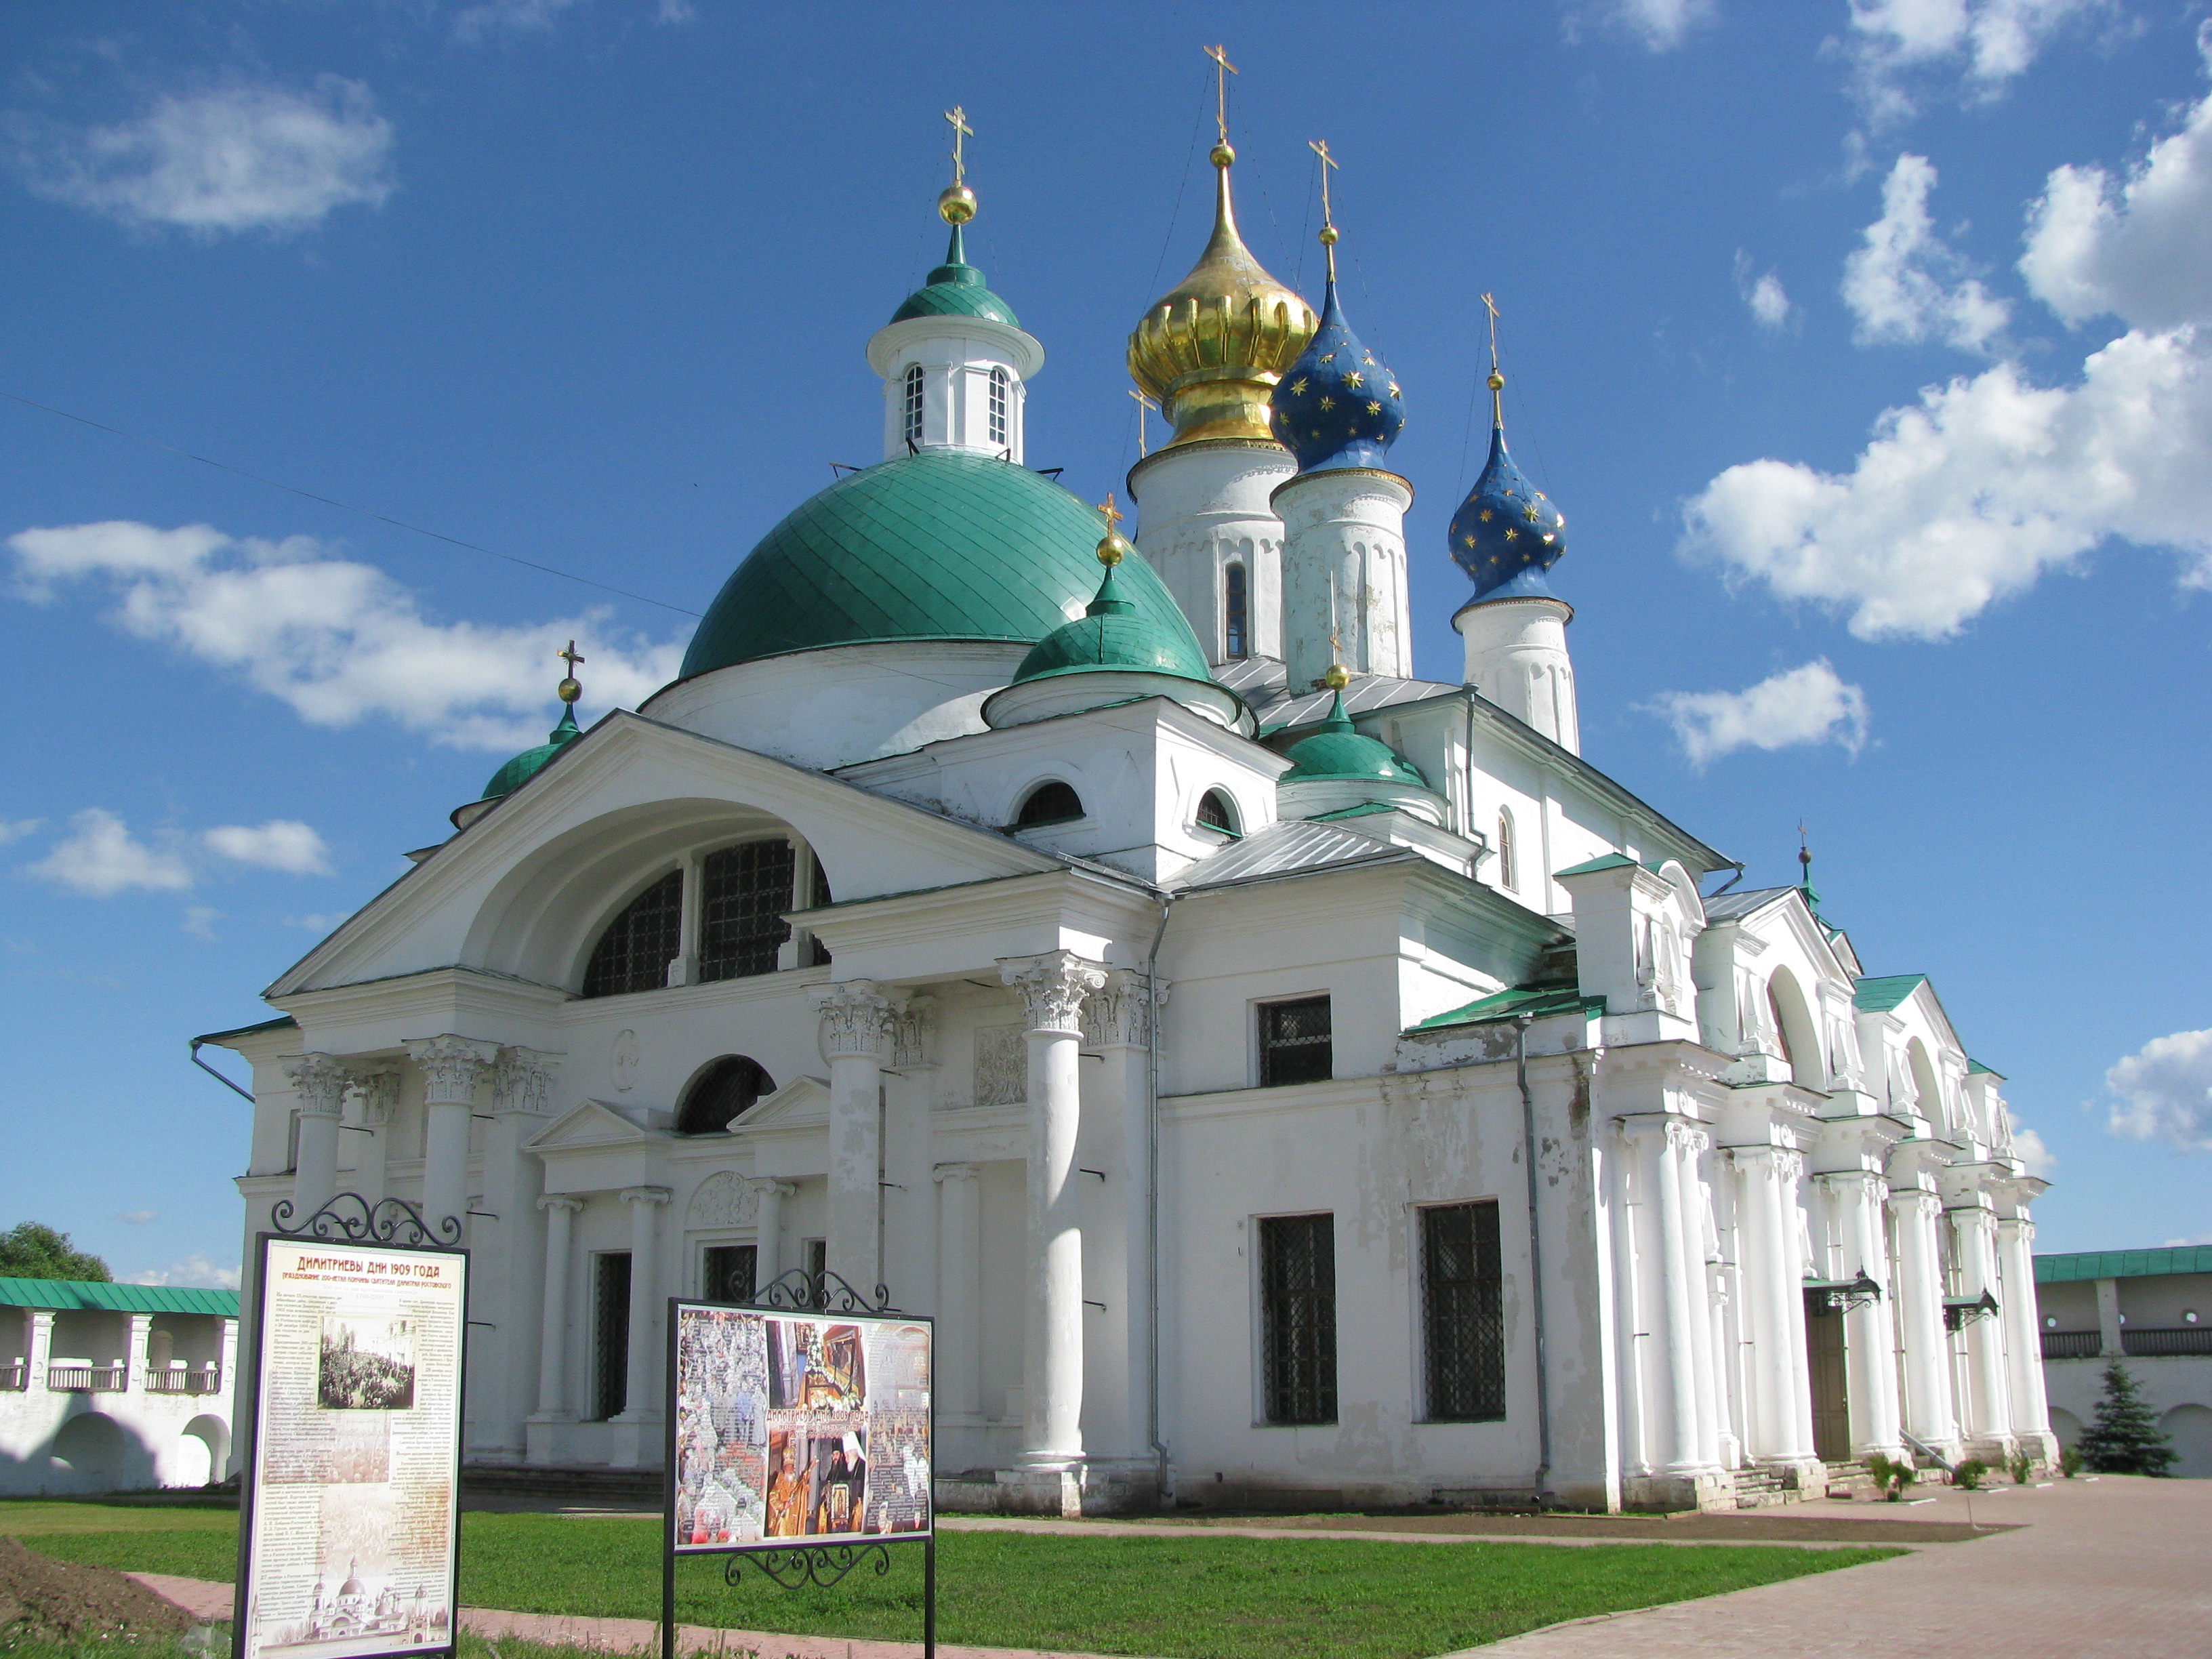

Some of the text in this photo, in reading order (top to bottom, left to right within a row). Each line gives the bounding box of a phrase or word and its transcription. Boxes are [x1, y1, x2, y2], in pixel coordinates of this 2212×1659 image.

[297, 1256, 440, 1278] ДИМИТРИЕВЫ ДНИ 1909 ГОДА
[766, 1409, 813, 1422] ДИМИТРИЕВЫ
[816, 1410, 831, 1422] ДНИ
[850, 1410, 869, 1422] ГОДА
